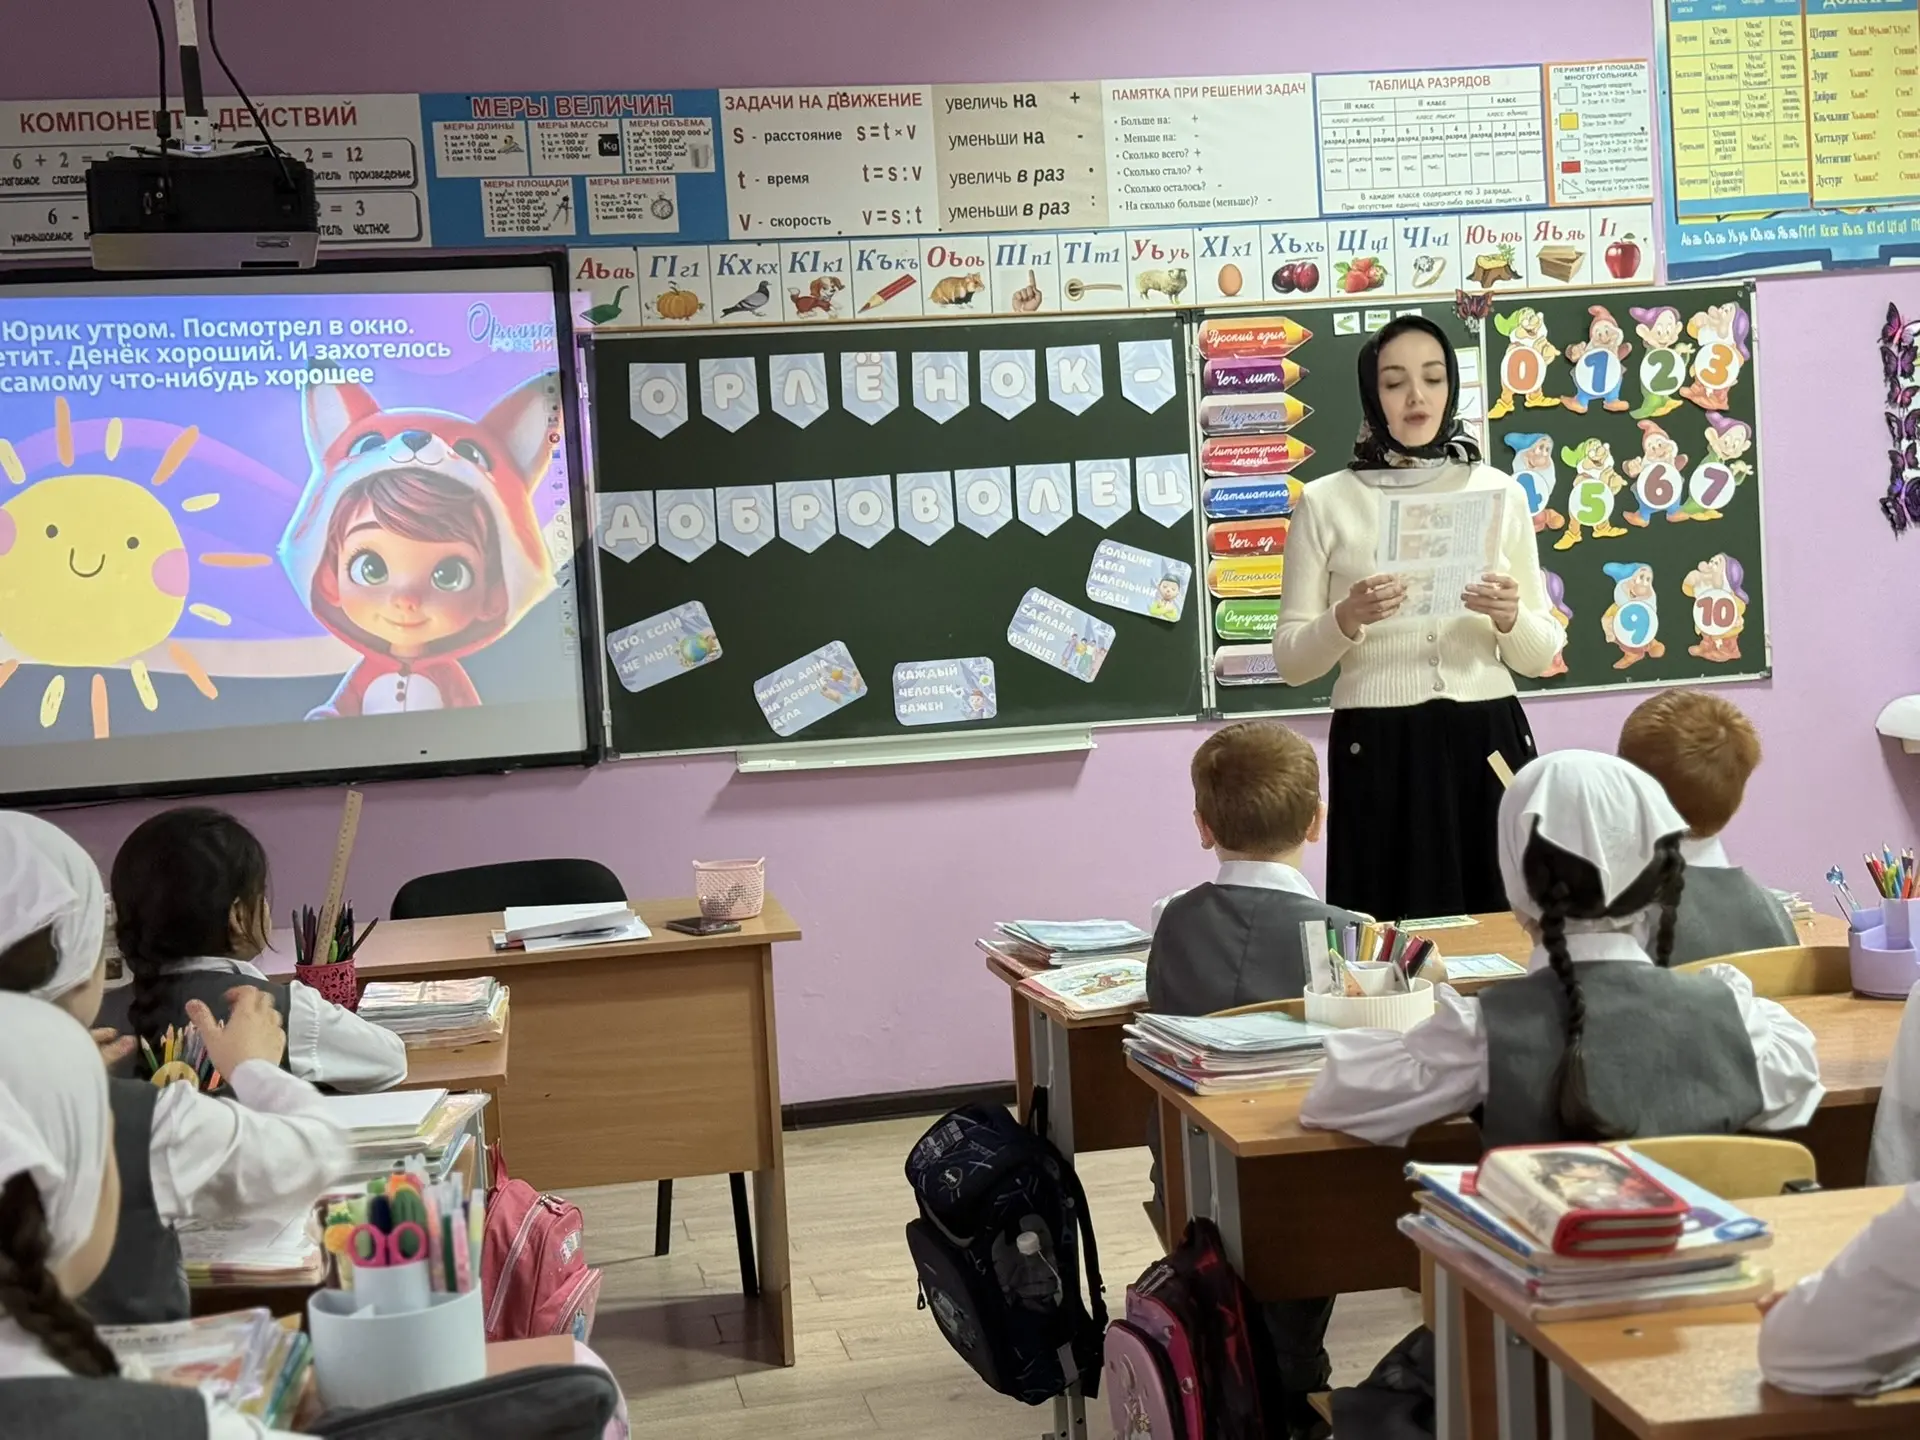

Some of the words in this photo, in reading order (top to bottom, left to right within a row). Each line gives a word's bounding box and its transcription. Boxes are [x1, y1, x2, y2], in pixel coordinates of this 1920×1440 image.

[1112, 88, 1170, 101] ПАМЯТКА
[1174, 86, 1198, 99] ПРИ
[1202, 84, 1263, 98] РЕШЕНИИ
[1265, 82, 1306, 97] ЗАДАЧ
[1368, 79, 1425, 92] ТАБЛИЦА
[1427, 75, 1491, 90] РАЗРЯДОВ
[471, 96, 548, 118] МЕРЫ
[555, 94, 674, 118] ВЕЛИЧИН
[724, 95, 794, 112] ЗАДАЧИ
[800, 95, 823, 110] НА
[827, 92, 923, 111] ДВИЖЕНИЕ
[945, 96, 1008, 114] увеличь
[1013, 92, 1037, 109] на
[218, 101, 358, 132] ДЕЙСТВИЙ
[443, 123, 474, 131] МЕРЫ
[476, 122, 515, 131] ДЛИНЫ
[570, 121, 609, 129] МАССЫ
[1121, 116, 1155, 126] Больше
[1157, 116, 1171, 125] на:
[603, 142, 618, 152] Kg
[764, 130, 843, 145] расстояние
[948, 132, 1018, 151] уменьши
[1023, 130, 1045, 145] на
[1124, 133, 1160, 144] Меньше
[1163, 133, 1177, 142] на:
[346, 147, 364, 162] 12
[1122, 150, 1160, 161] Сколько
[1162, 148, 1189, 159] всего?
[349, 169, 411, 183] произведение
[590, 178, 621, 186] МЕРЫ
[622, 177, 670, 185] ВРЕМЕНИ
[767, 173, 810, 187] время
[949, 171, 1011, 188] увеличь
[1017, 169, 1028, 183] в
[1033, 168, 1065, 187] раз
[1123, 167, 1160, 178] Сколько
[1162, 165, 1191, 176] стало?
[484, 180, 515, 188] МЕРЫ
[517, 179, 569, 188] ПЛОЩАДИ
[1124, 184, 1161, 195] Сколько
[1163, 181, 1206, 192] осталось?
[948, 204, 1018, 223] уменьши
[1023, 202, 1033, 216] в
[1038, 201, 1070, 220] раз
[1125, 201, 1138, 211] На
[1140, 200, 1175, 210] сколько
[1177, 198, 1211, 209] больше
[1213, 196, 1259, 208] (меньше)?
[353, 222, 390, 236] частное
[770, 216, 832, 229] скорость
[1533, 220, 1563, 241] Яь
[11, 232, 74, 246] уменьшаемое
[1268, 232, 1302, 254] Хь
[1465, 224, 1497, 244] Юь
[856, 249, 892, 271] Къ
[927, 246, 962, 268] Оь
[1131, 239, 1164, 260] Уь
[576, 257, 610, 280] Аь
[717, 253, 752, 275] Кх
[1, 320, 81, 347] Юрик
[86, 321, 176, 346] утром.
[183, 317, 322, 342] Посмотрел
[329, 322, 343, 336] в
[350, 319, 414, 336] окно.
[1207, 330, 1254, 348] Русский
[1257, 330, 1286, 346] язык
[67, 343, 151, 370] Денёк
[156, 340, 283, 369] хороший.
[290, 341, 308, 360] И
[315, 340, 452, 361] захотелось
[1708, 343, 1733, 386] 3
[1245, 375, 1280, 384] лит.
[1506, 349, 1538, 391] 0
[1584, 349, 1609, 392] 1
[1650, 349, 1678, 392] 2
[1, 373, 103, 397] самому
[110, 366, 259, 392] что-нибудь
[265, 367, 374, 392] хорошее
[1213, 405, 1280, 429] Музыка
[1209, 443, 1288, 459] Литературное
[1643, 464, 1674, 506] 6
[1702, 467, 1730, 507] 7
[1211, 490, 1290, 502] Математика
[1577, 481, 1606, 524] 5
[1257, 537, 1277, 551] яз.
[1095, 559, 1126, 573] ДЕЛА
[1100, 545, 1153, 567] БОЛЬШИЕ
[1089, 586, 1129, 605] СЕРДЕЦ
[1091, 572, 1157, 598] МАЛЕНЬКИХ
[1031, 592, 1074, 619] ВМЕСТЕ
[1697, 596, 1735, 628] 10
[1021, 604, 1075, 634] СДЕЛАЕМ
[1619, 602, 1650, 644] 9
[613, 634, 645, 653] КТО,
[646, 616, 682, 639] ЕСЛИ
[1027, 624, 1055, 642] МИР
[1009, 632, 1056, 661] ЛУЧШЕ!
[622, 658, 640, 674] НЕ
[644, 644, 673, 665] МЫ?
[758, 678, 795, 701] ЖИЗНЬ
[798, 659, 829, 681] ДАНА
[897, 663, 958, 681] КАЖДЫЙ
[763, 701, 781, 715] НА
[783, 677, 828, 706] ДОБРЫЕ
[898, 684, 953, 698] ЧЕЛОВЕК
[900, 701, 944, 714] ВАЖЕН
[772, 708, 801, 730] ДЕЛА
